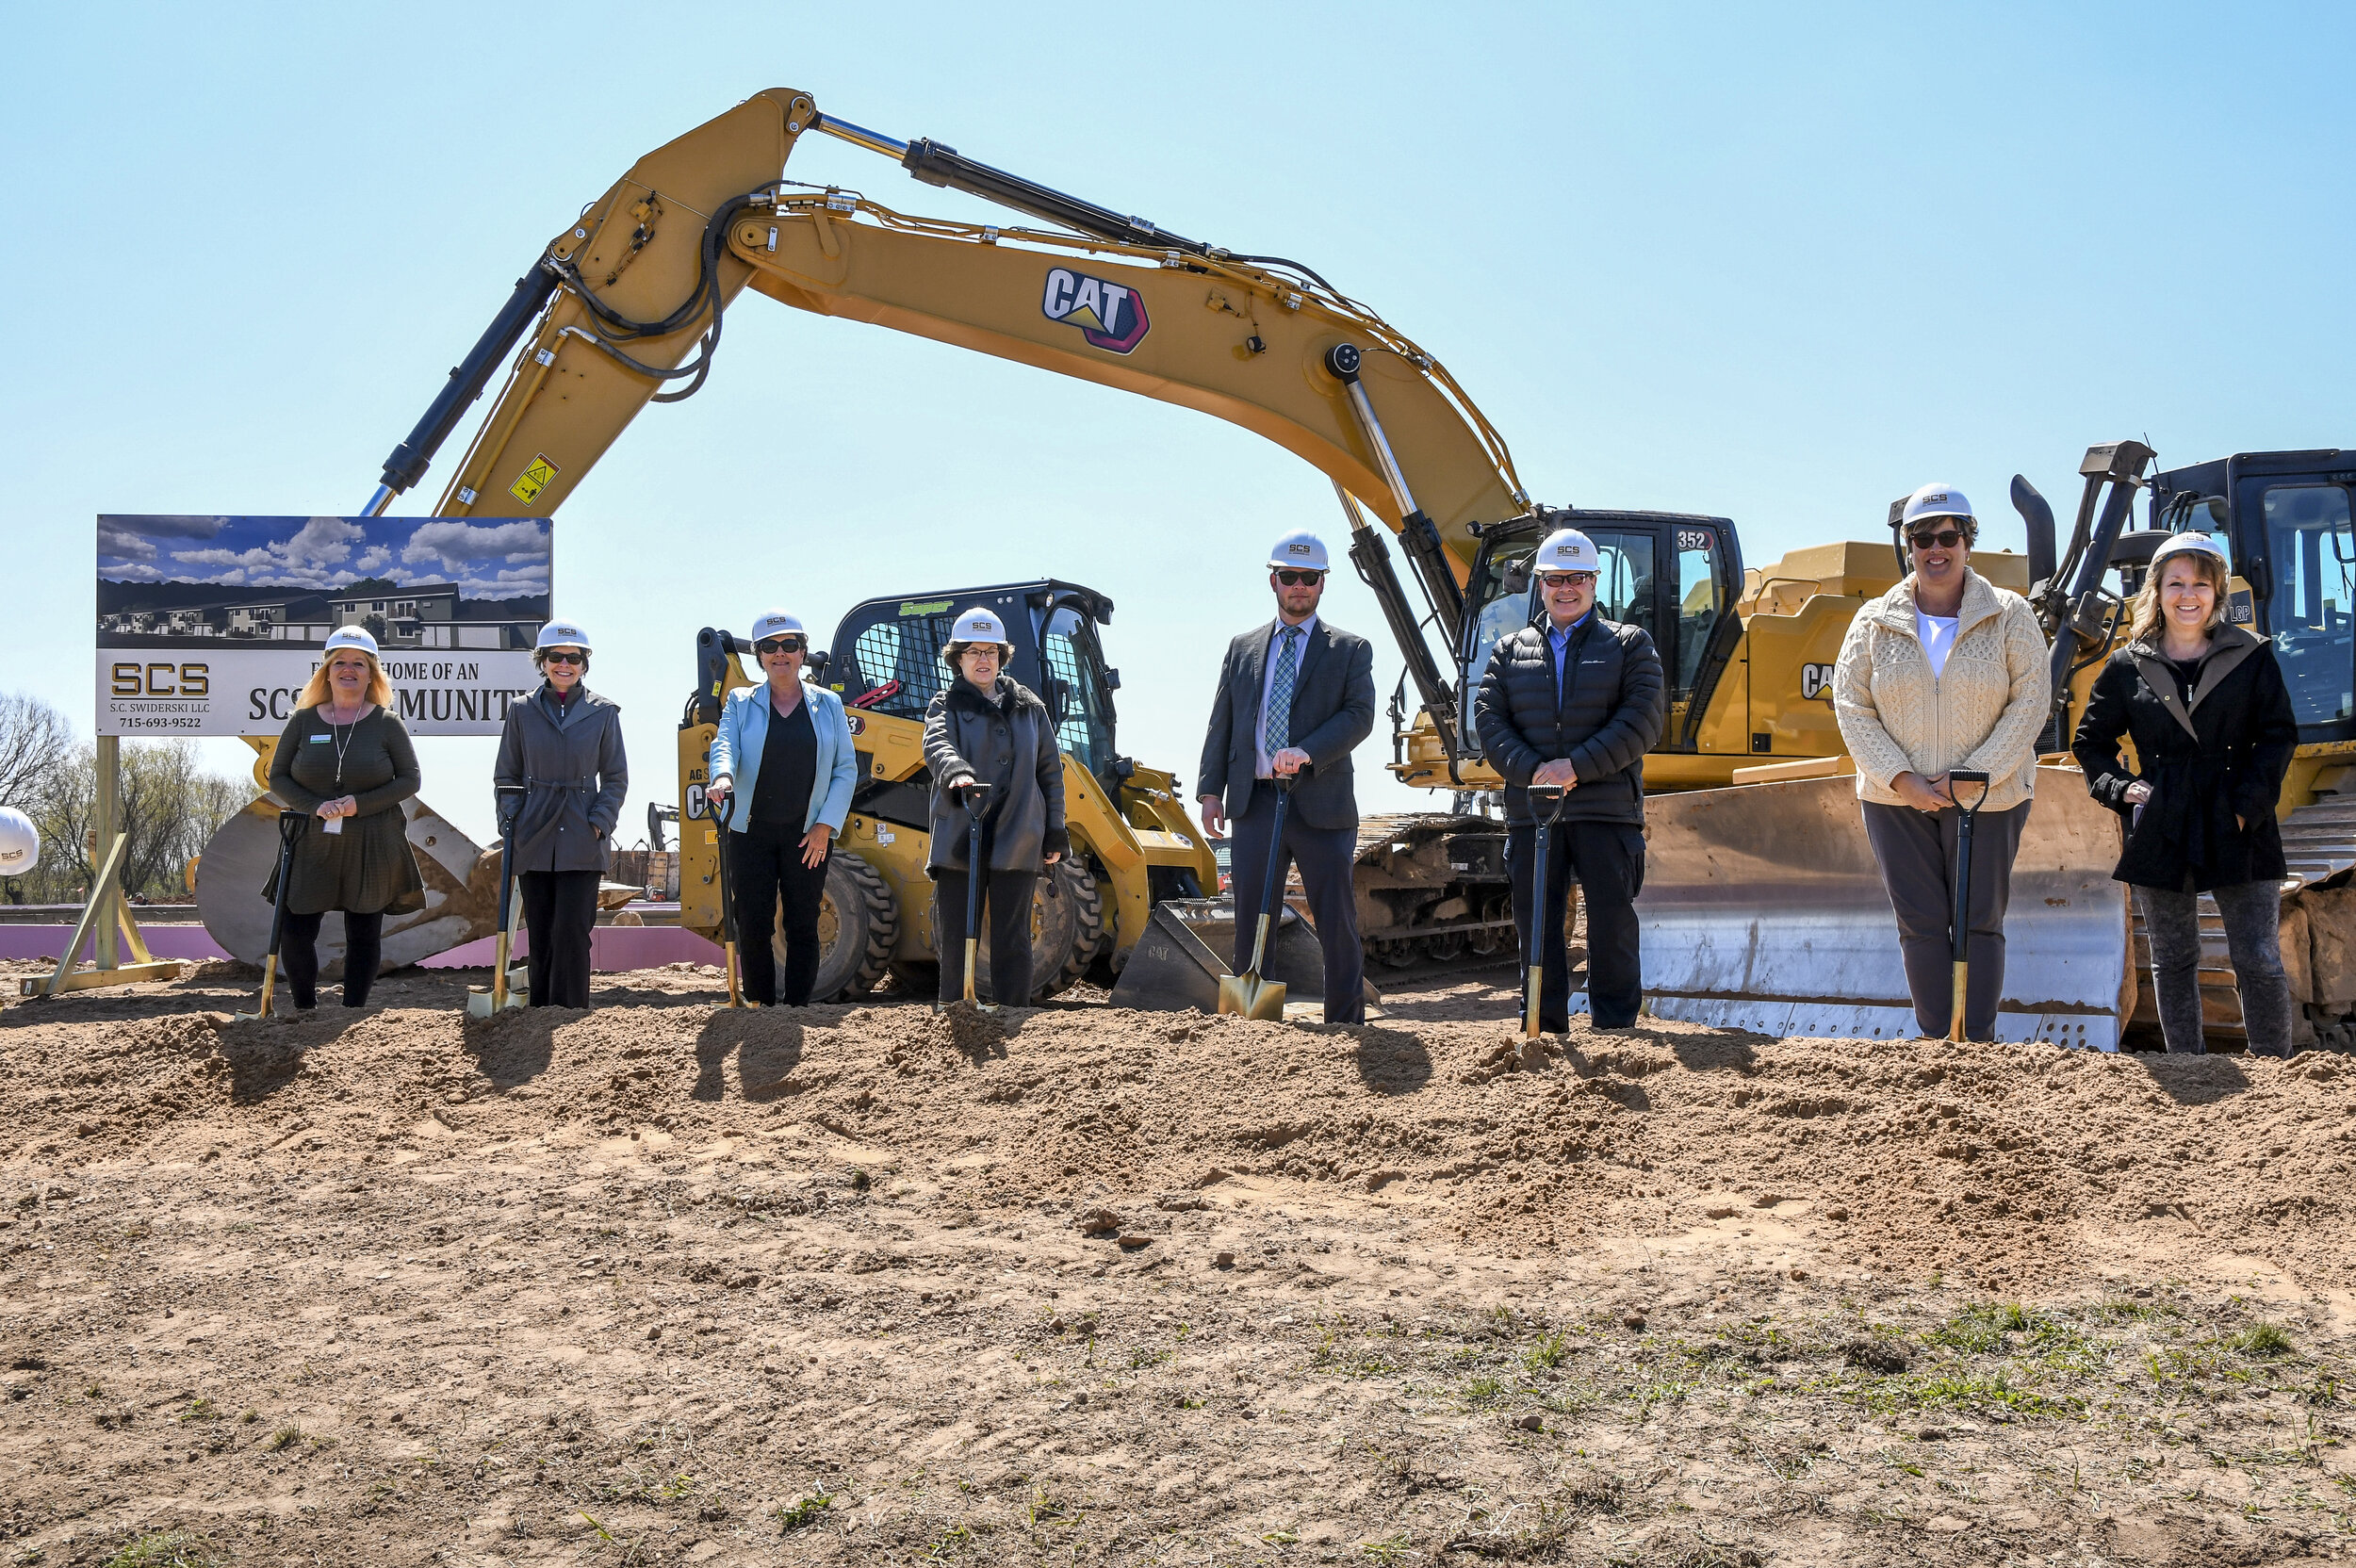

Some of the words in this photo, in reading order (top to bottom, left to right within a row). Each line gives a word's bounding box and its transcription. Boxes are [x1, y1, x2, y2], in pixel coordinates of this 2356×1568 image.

[1044, 269, 1128, 335] CAT
[1922, 494, 1948, 503] SCS
[1677, 531, 1705, 548] 352
[1289, 544, 1311, 552] SCS
[1557, 546, 1580, 554] SCS
[766, 616, 786, 625] SCS
[2230, 605, 2250, 622] LGP
[432, 662, 453, 680] OF
[456, 662, 479, 680] AN
[112, 662, 209, 695] SCS
[1802, 663, 1834, 698] CA
[110, 704, 127, 712] S.C.
[129, 704, 188, 712] SWIDERSKI
[191, 704, 210, 713] LLC
[392, 689, 535, 722] MUNIT
[120, 717, 201, 728] 715-693-9522
[689, 769, 702, 781] AG
[1, 849, 24, 859] SCS
[1147, 945, 1170, 962] CAT
